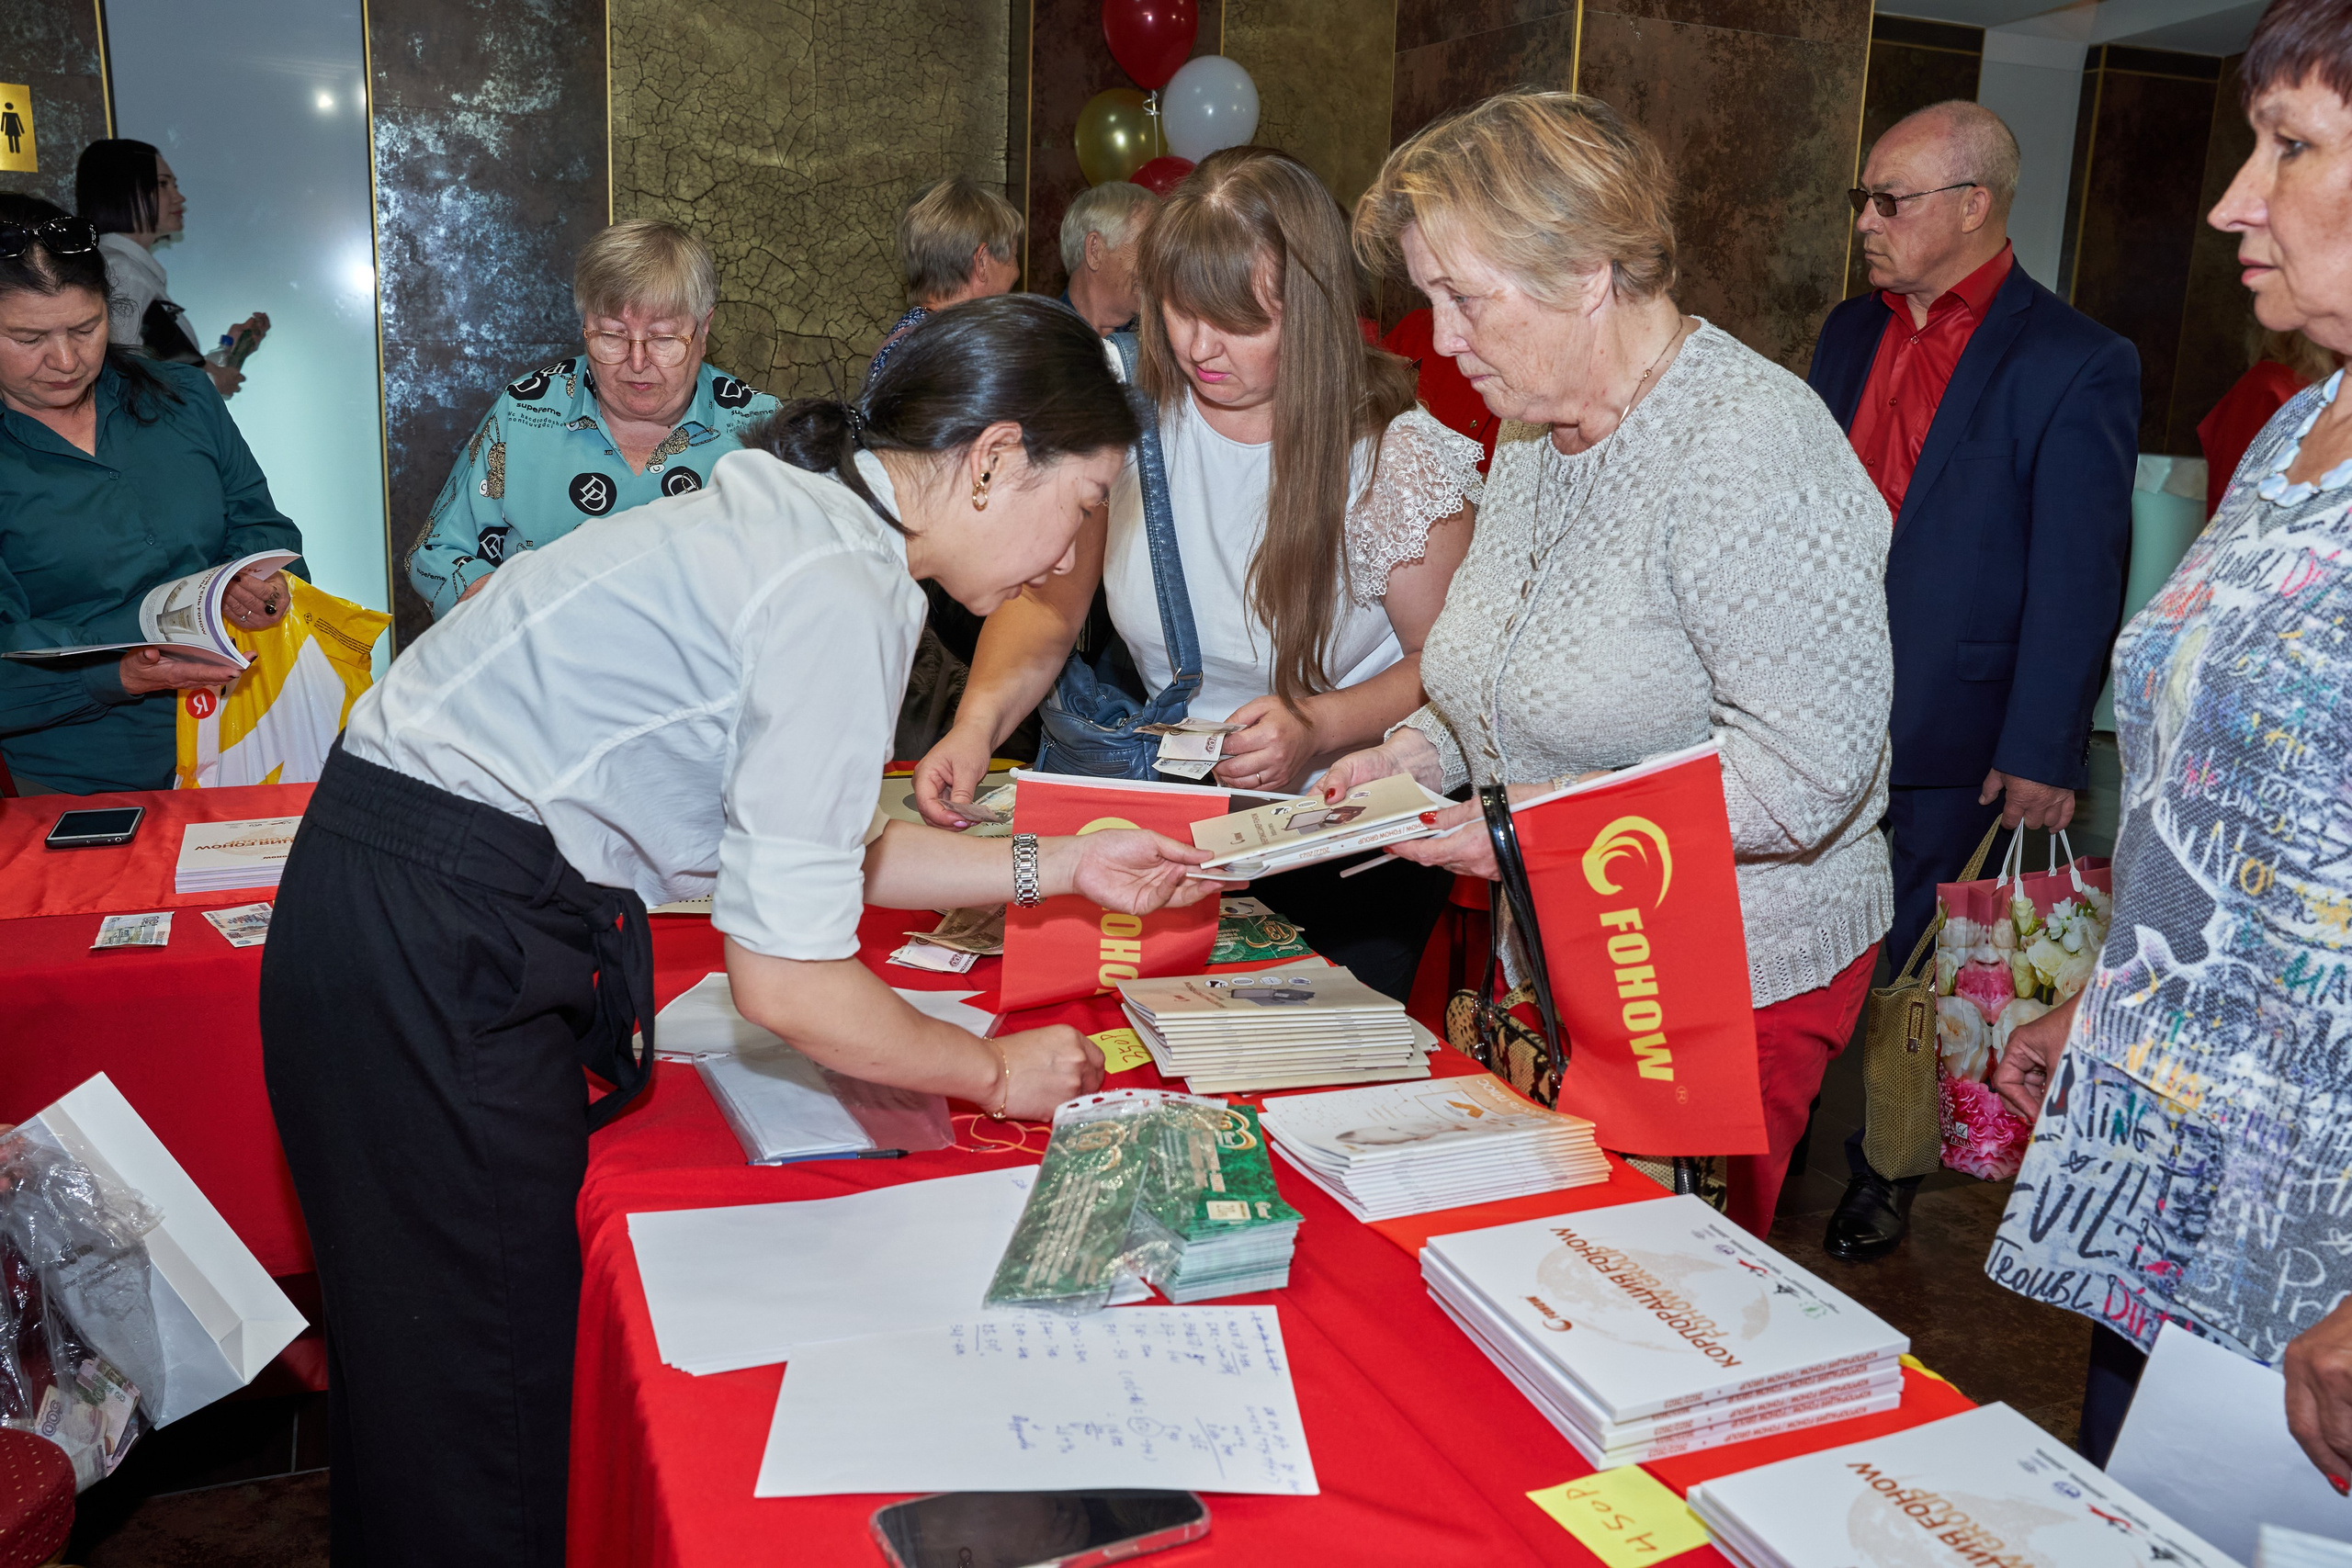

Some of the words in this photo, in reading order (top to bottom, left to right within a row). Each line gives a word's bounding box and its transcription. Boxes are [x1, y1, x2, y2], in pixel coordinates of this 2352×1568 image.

[193, 693, 209, 715] Я
[1358, 833, 1379, 844] GROUP
[1379, 828, 1402, 840] FOHOW
[1263, 925, 1290, 941] 13
[1600, 908, 1674, 1081] FOHOW
[1550, 1228, 1610, 1274] FOHOW
[1608, 1274, 1742, 1369] КОРПОРАЦИЯ
[1596, 1246, 1661, 1288] GROUP
[1652, 1289, 1729, 1337] FOHOW
[41, 1399, 62, 1437] 500
[1847, 1462, 1947, 1531] FOHOW
